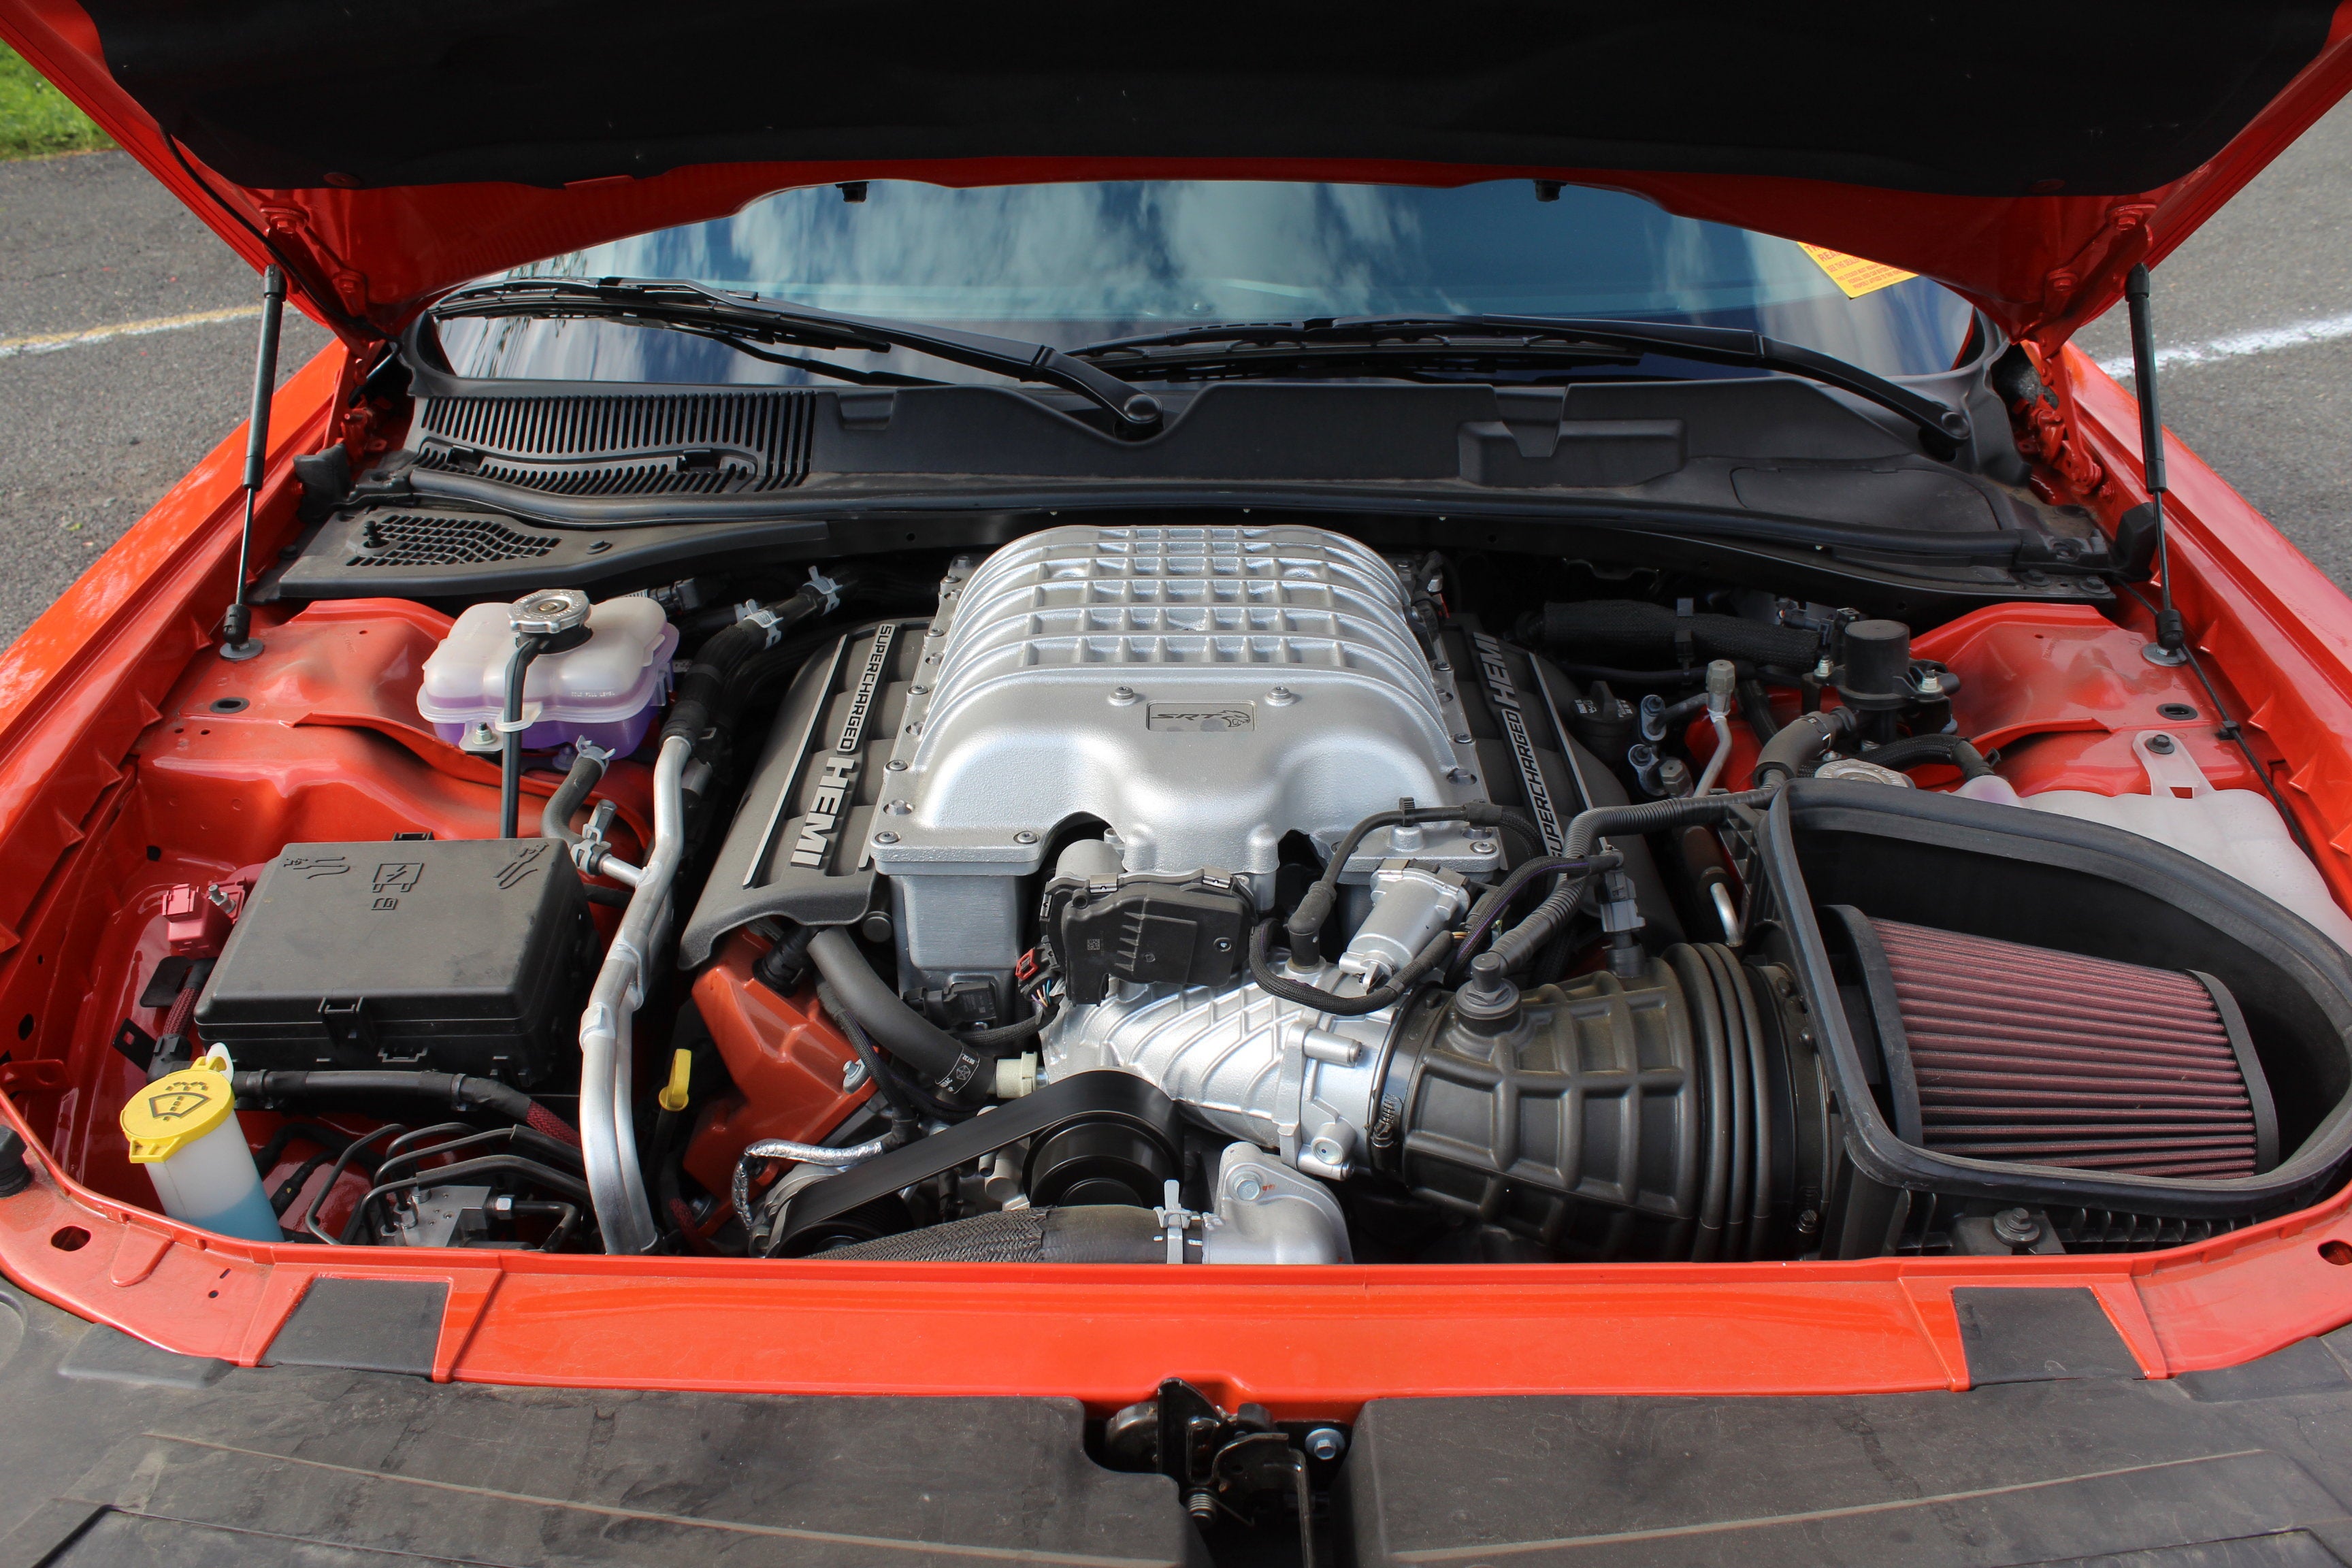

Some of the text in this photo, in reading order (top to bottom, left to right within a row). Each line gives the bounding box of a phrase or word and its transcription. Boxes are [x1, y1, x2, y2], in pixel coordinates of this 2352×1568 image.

[839, 625, 892, 750] SUPERCHARGED
[1151, 713, 1223, 721] SRT
[1473, 632, 1521, 710] HEMI
[790, 757, 855, 868] HEMI
